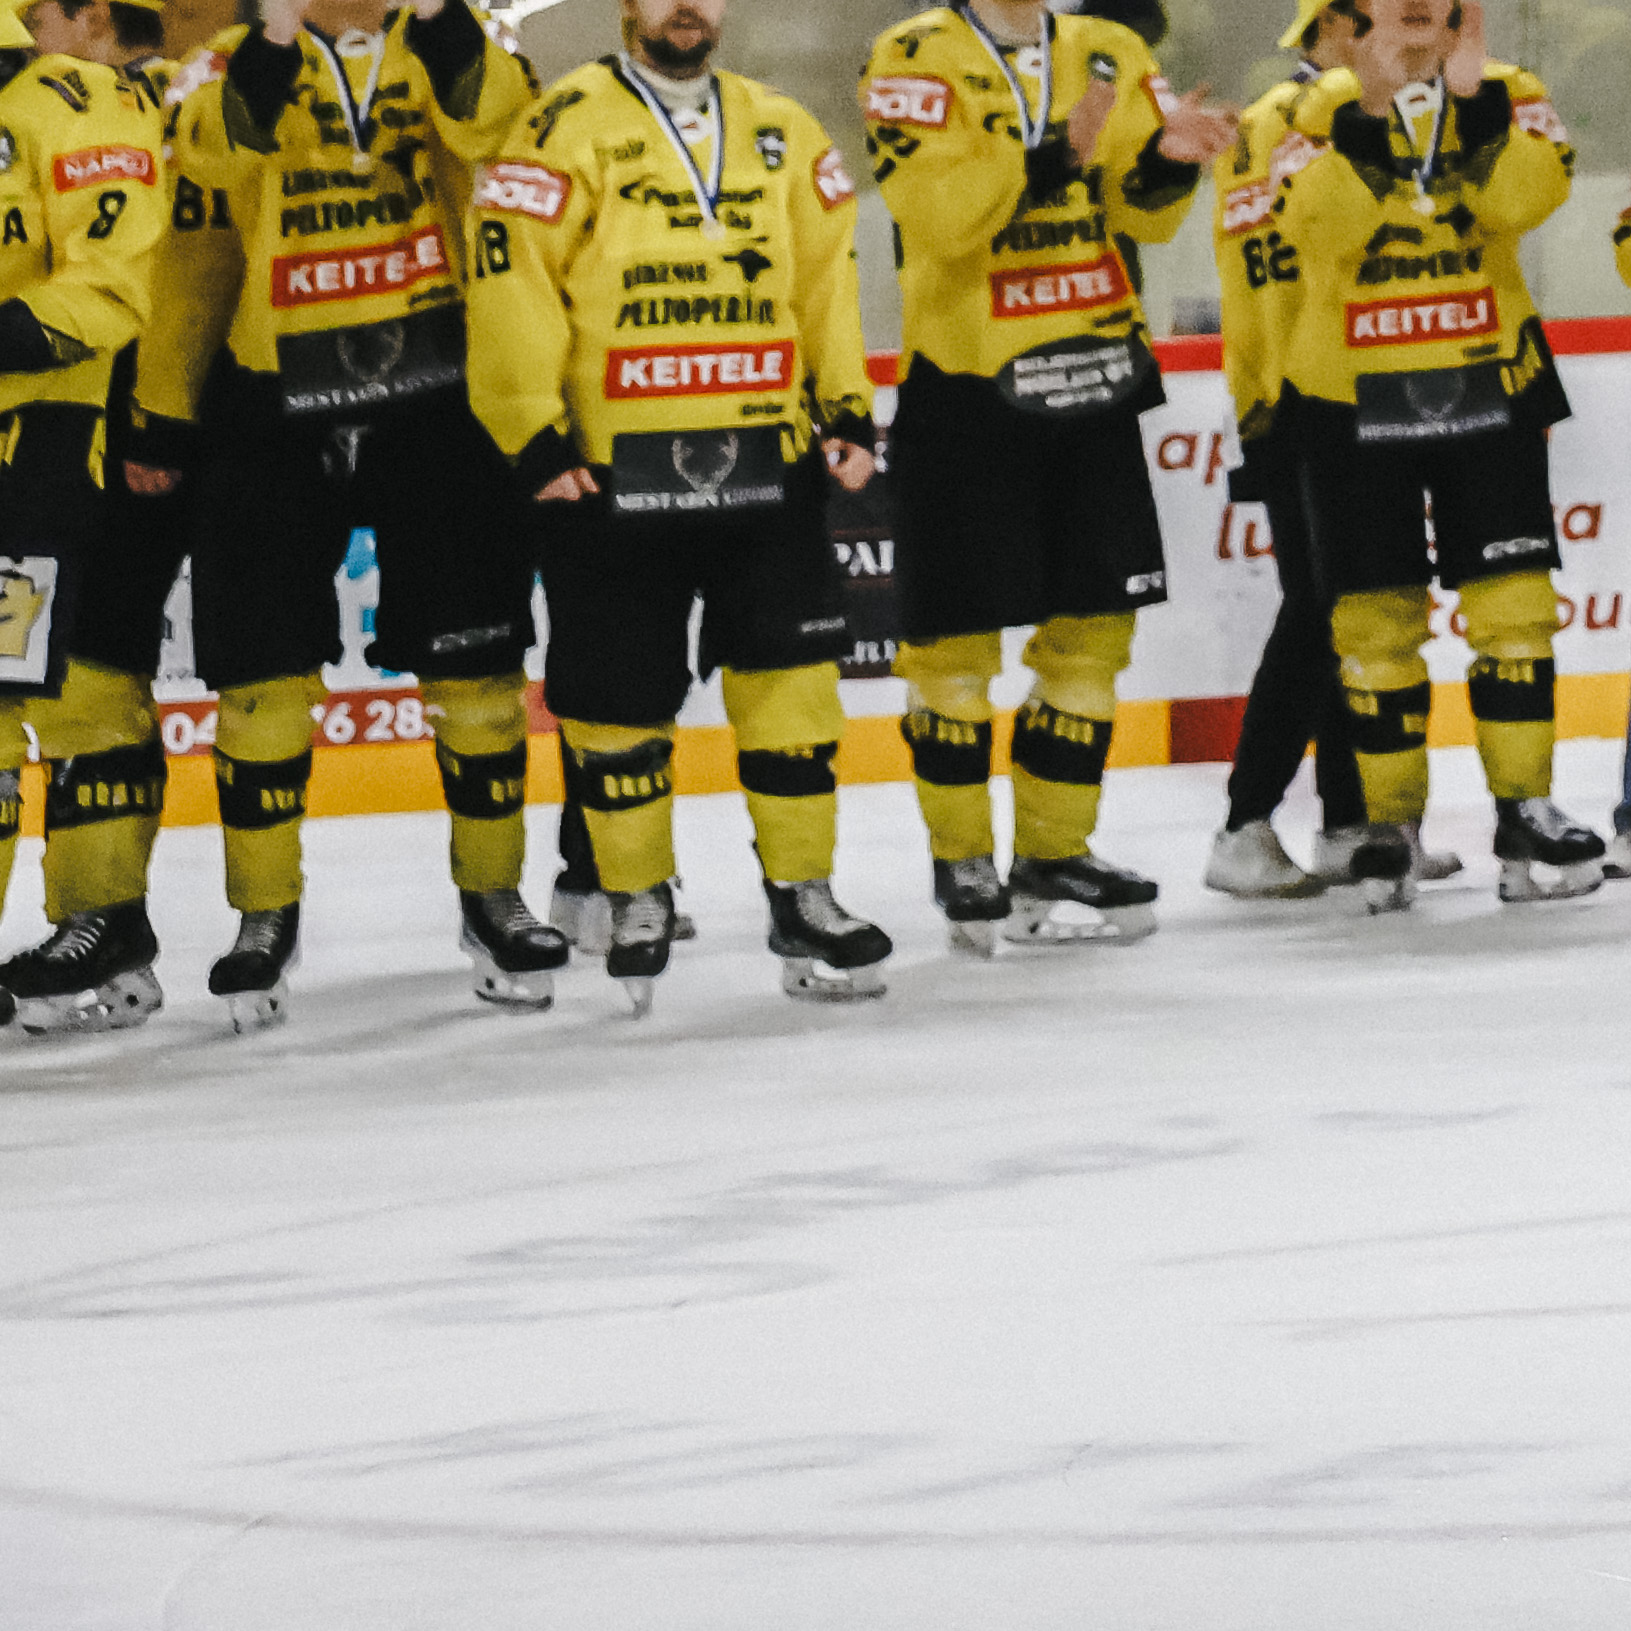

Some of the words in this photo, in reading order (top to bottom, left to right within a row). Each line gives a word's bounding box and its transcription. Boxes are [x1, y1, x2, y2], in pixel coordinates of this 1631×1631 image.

[3, 207, 28, 246] A
[288, 234, 437, 296] KEITEE
[620, 349, 784, 390] KEITELE
